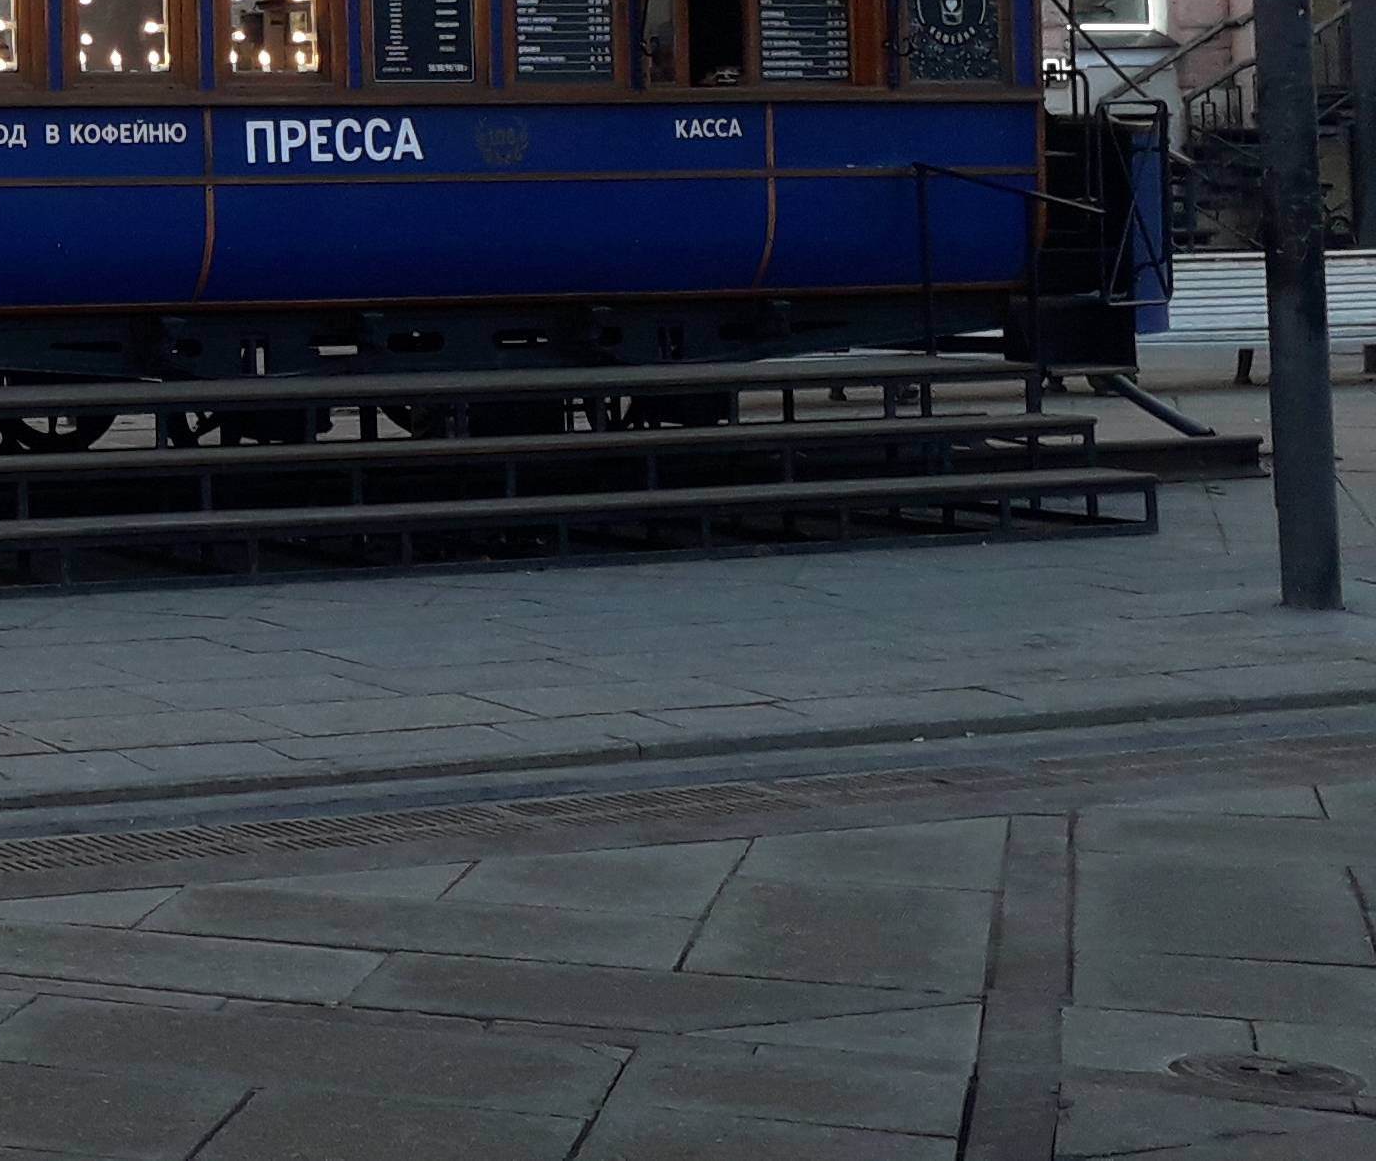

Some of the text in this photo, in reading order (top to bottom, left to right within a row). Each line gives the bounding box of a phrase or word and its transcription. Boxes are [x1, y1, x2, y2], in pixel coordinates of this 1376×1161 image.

[45, 124, 61, 145] В
[69, 118, 187, 145] КОФЕЙНЮ
[245, 117, 423, 164] ПРЕССА
[674, 117, 743, 139] КАССА
